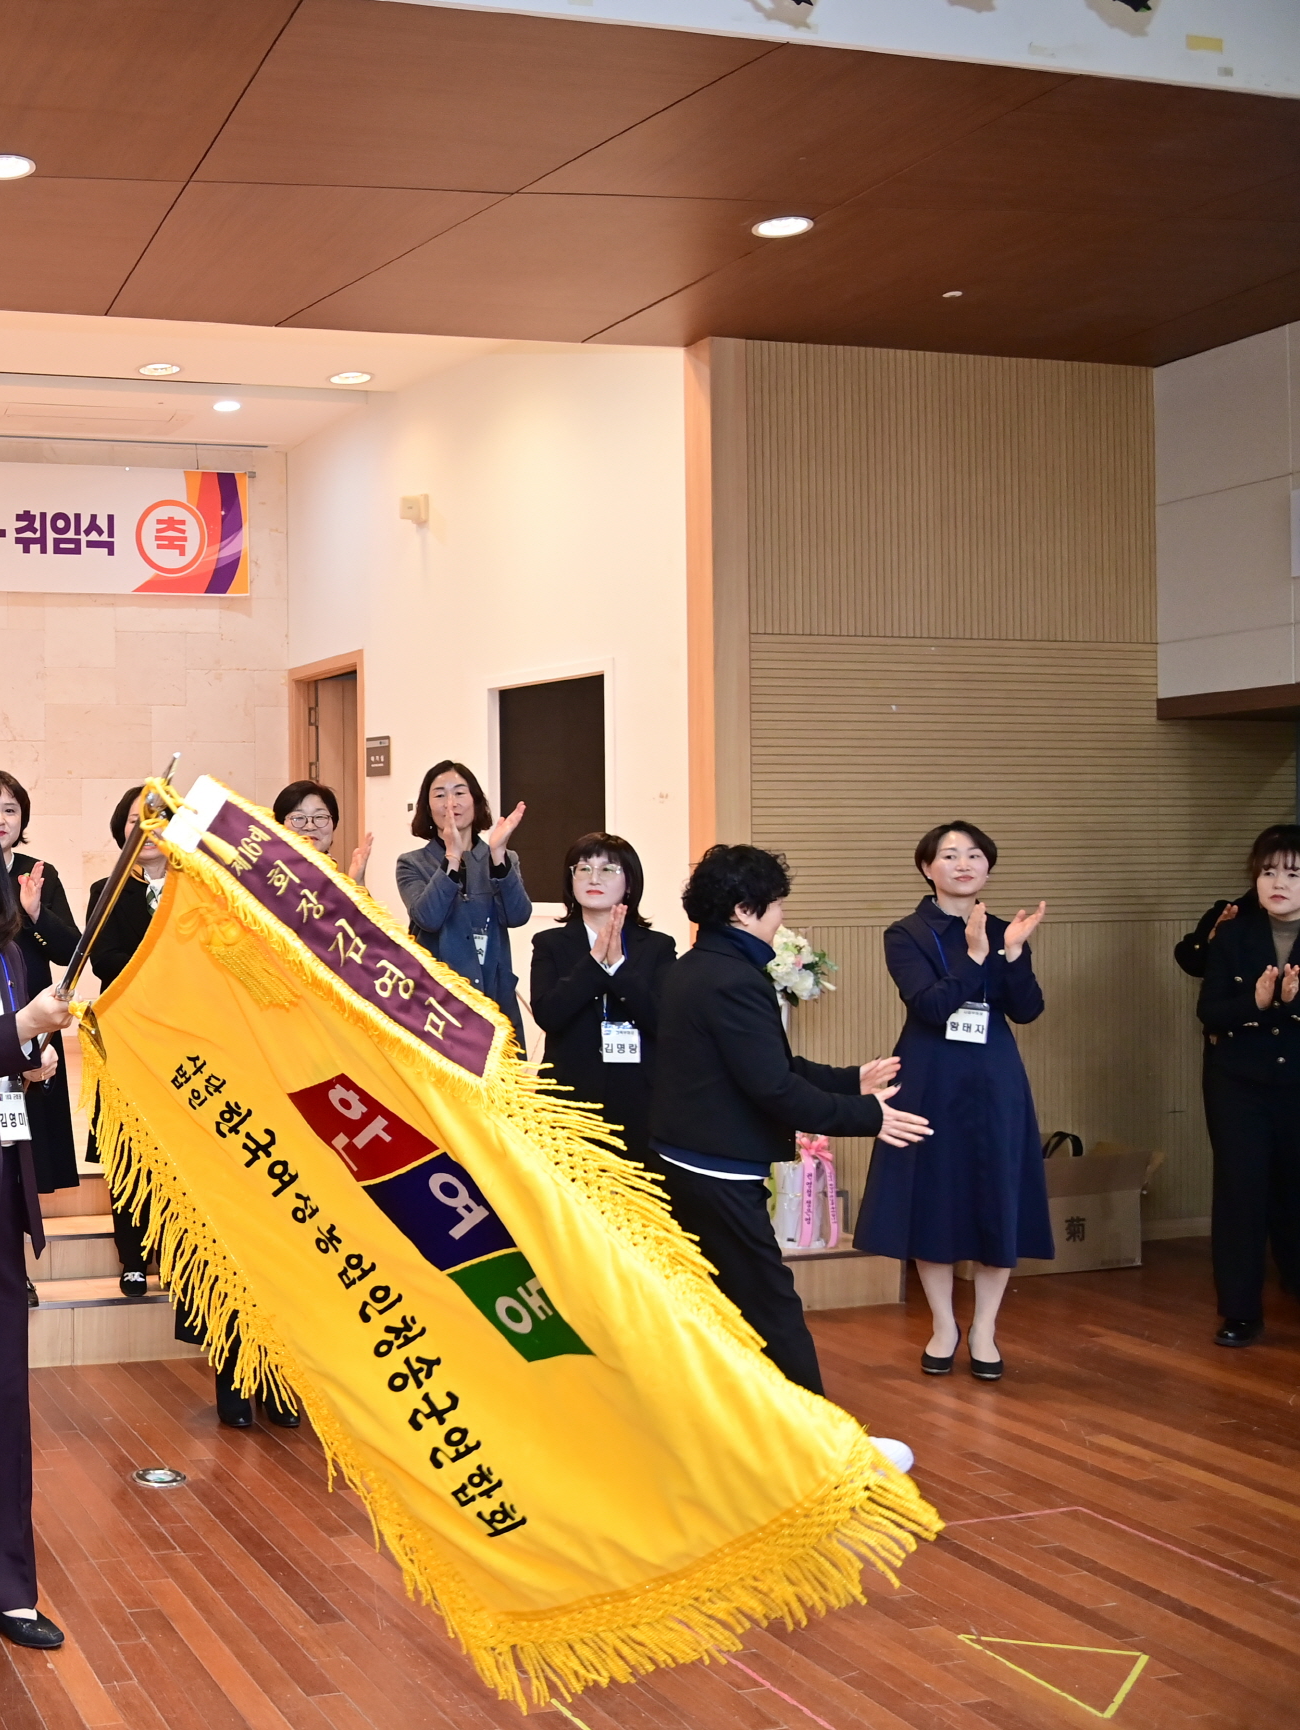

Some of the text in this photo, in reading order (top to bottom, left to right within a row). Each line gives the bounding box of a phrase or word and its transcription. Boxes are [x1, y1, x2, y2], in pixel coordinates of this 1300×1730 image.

[153, 516, 188, 557] 축
[231, 825, 272, 877] 제16대
[328, 918, 463, 1040] 김영미
[949, 1021, 985, 1034] 황태자
[0, 1112, 27, 1128] 김영미
